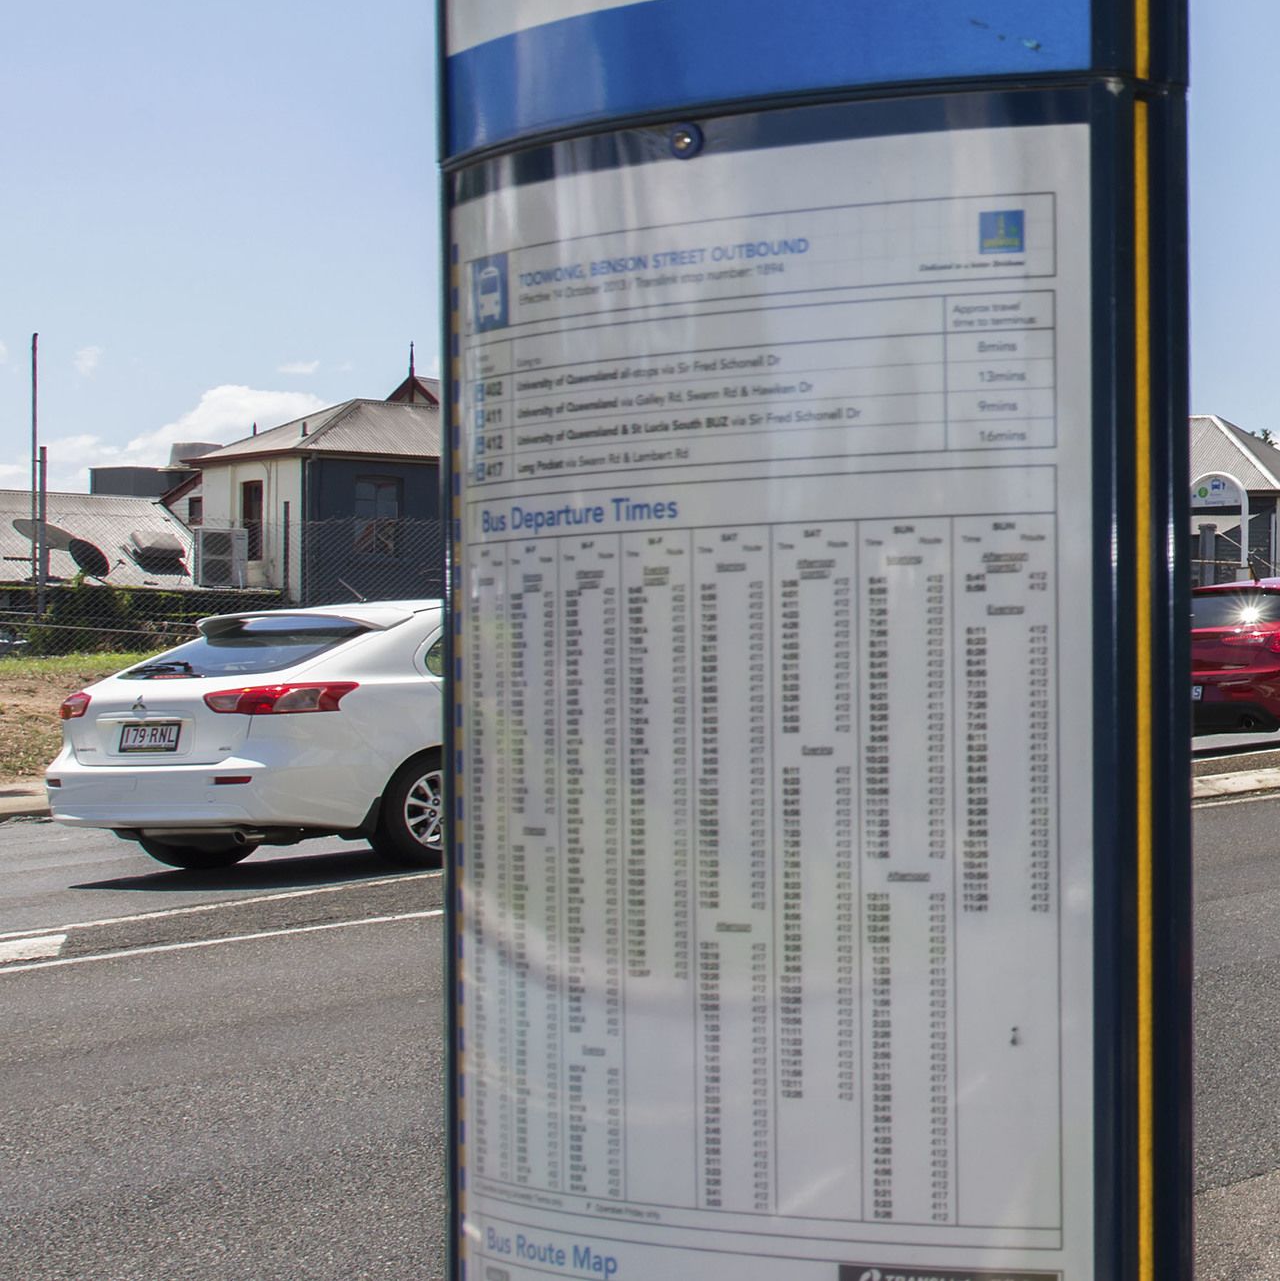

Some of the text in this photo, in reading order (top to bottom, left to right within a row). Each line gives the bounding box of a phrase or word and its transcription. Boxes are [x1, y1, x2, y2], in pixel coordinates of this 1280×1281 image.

[590, 255, 648, 277] BENSON
[652, 248, 706, 269] STREET
[711, 238, 810, 262] OUTBOUND
[516, 378, 553, 392] University
[566, 370, 618, 385] Queensland
[693, 360, 717, 372] Fred
[767, 353, 781, 366] Dr
[517, 405, 553, 419] University
[566, 399, 618, 413] Queensland
[723, 387, 737, 399] Rd
[799, 381, 813, 393] Dr
[517, 433, 553, 446] University
[566, 425, 618, 440] Queensland
[672, 419, 702, 431] South
[705, 415, 728, 428] BUZ
[766, 411, 793, 423] Fred
[846, 407, 862, 419] Dr
[608, 452, 621, 465] Rd
[675, 448, 689, 459] Rd
[482, 498, 678, 534] Bus Departure Times
[486, 1226, 618, 1279] Bus Route Map
